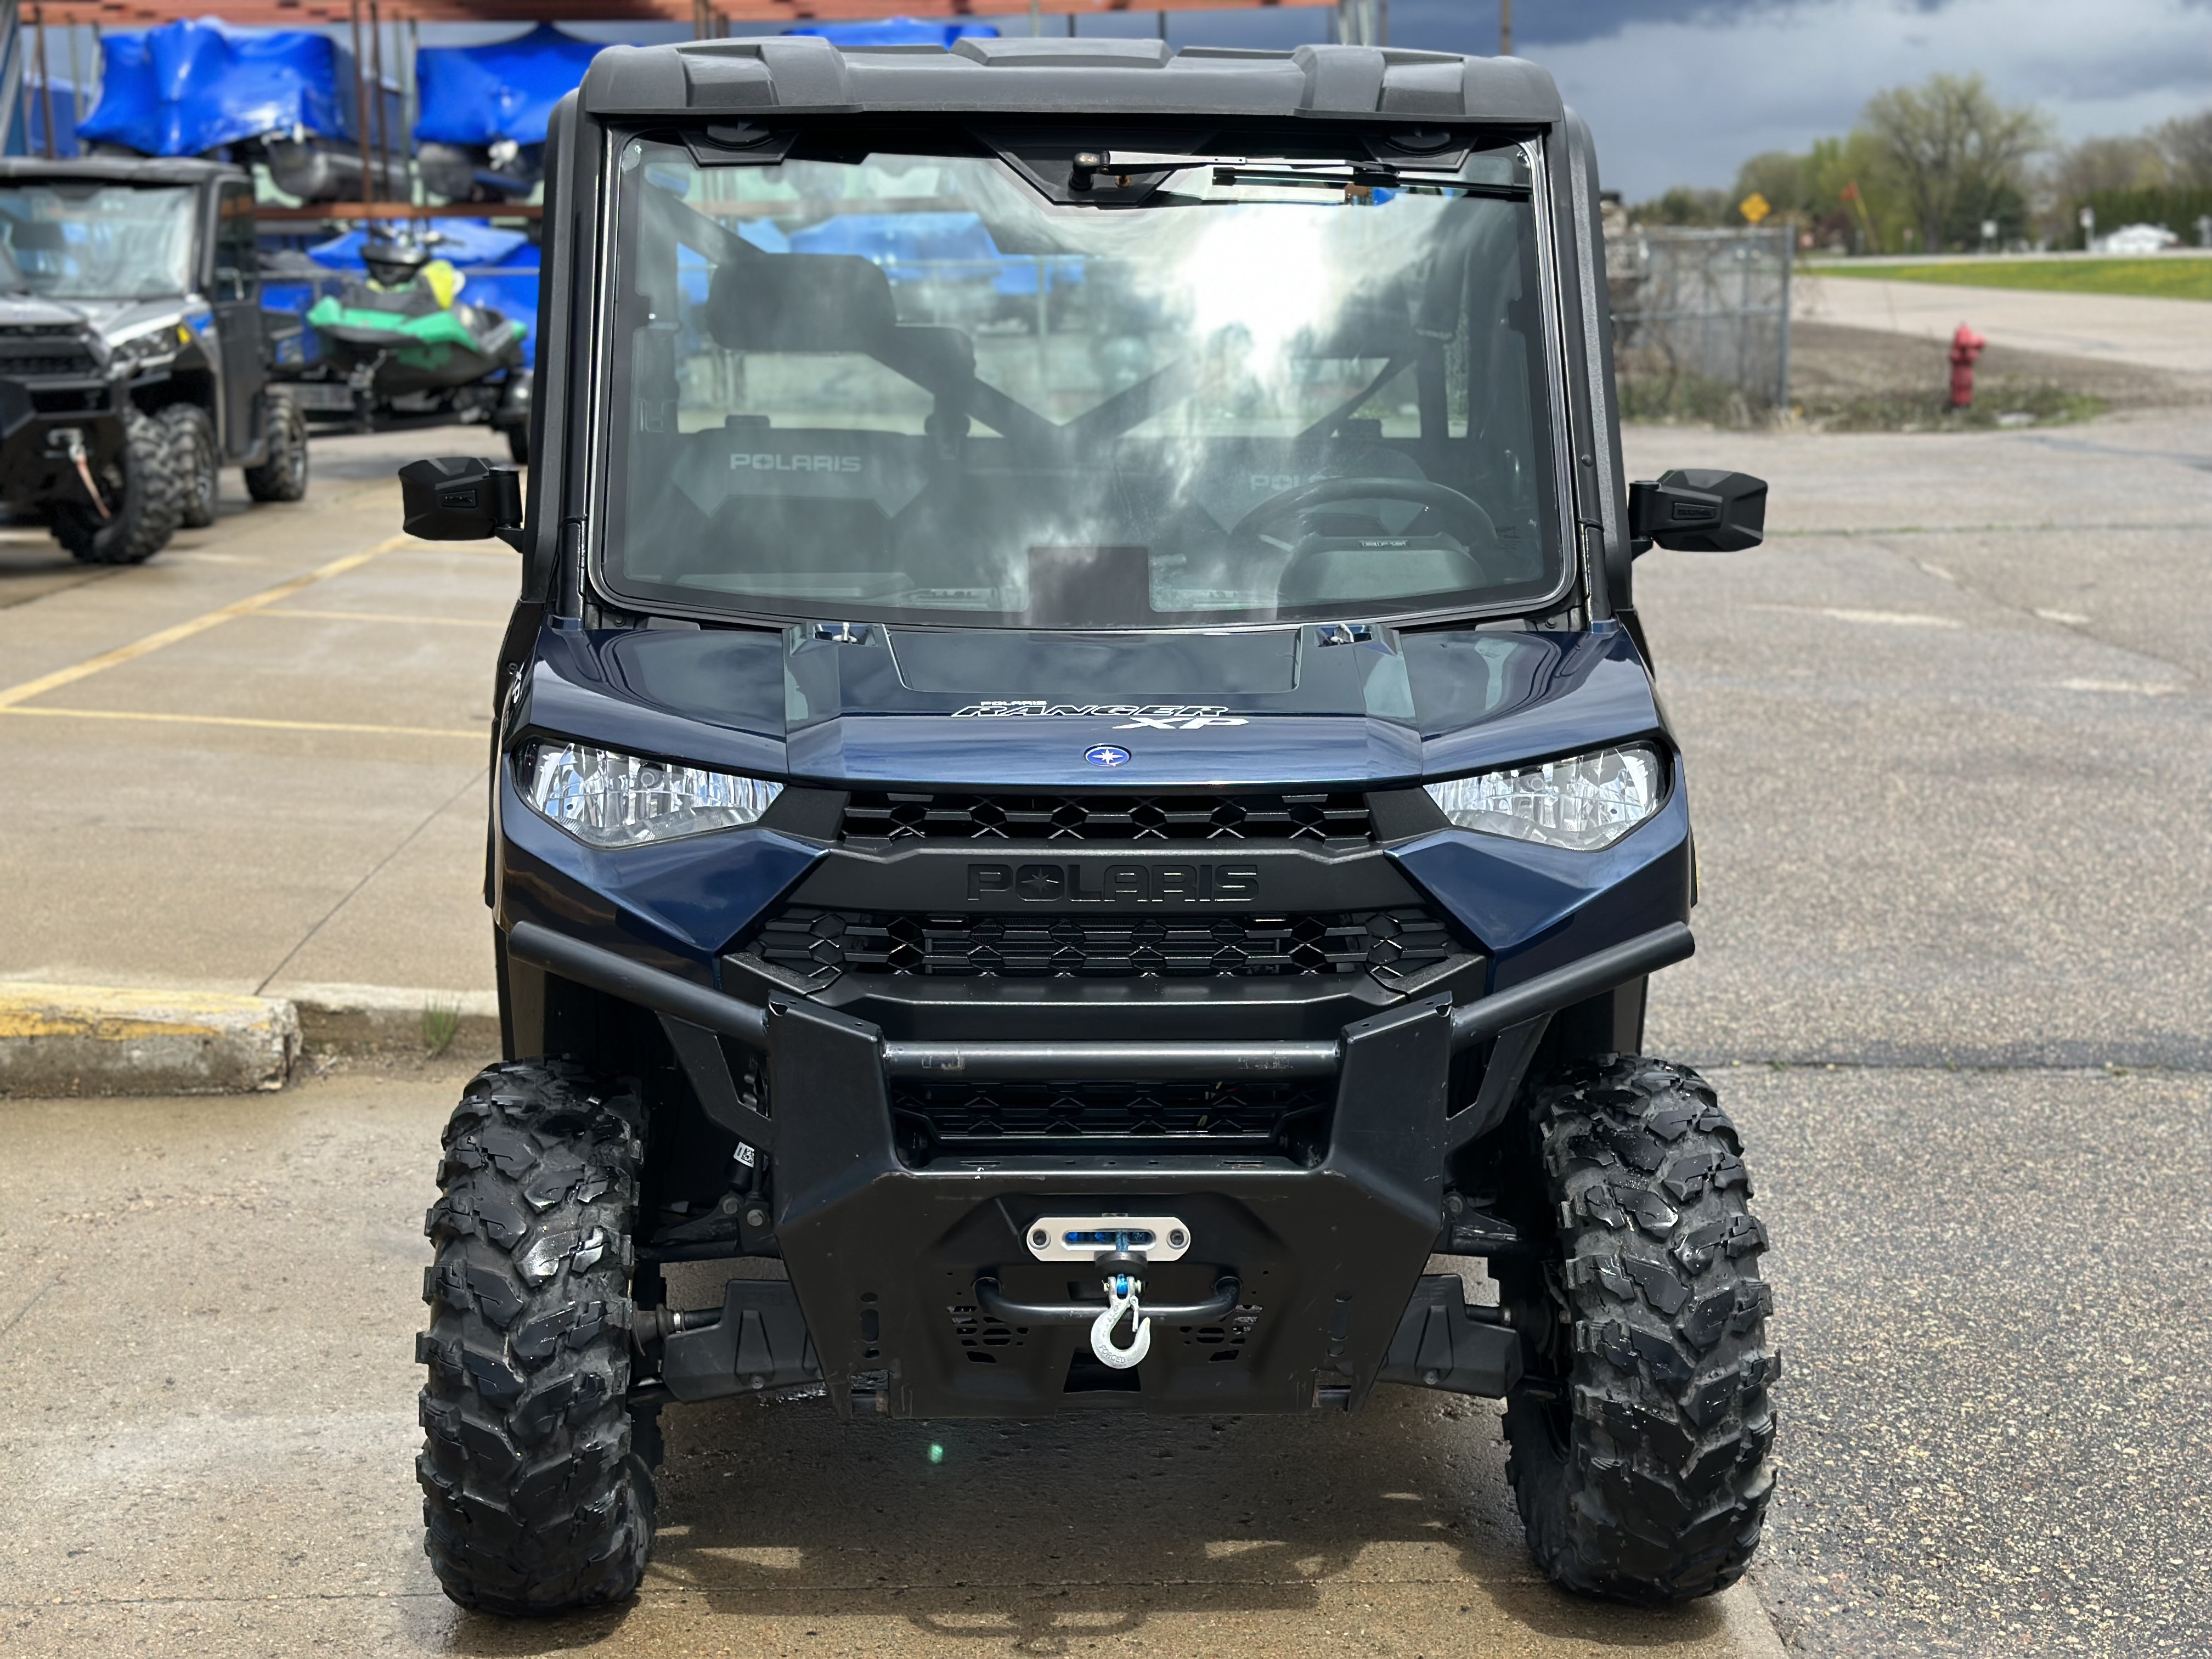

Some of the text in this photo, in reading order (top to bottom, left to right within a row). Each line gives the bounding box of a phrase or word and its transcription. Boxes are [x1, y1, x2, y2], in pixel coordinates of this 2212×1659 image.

[730, 454, 861, 472] POLARIS
[951, 705, 1229, 717] RANGER
[1111, 717, 1249, 730] XP
[967, 864, 1259, 902] POLARIS
[1099, 1345, 1126, 1363] FORGED
